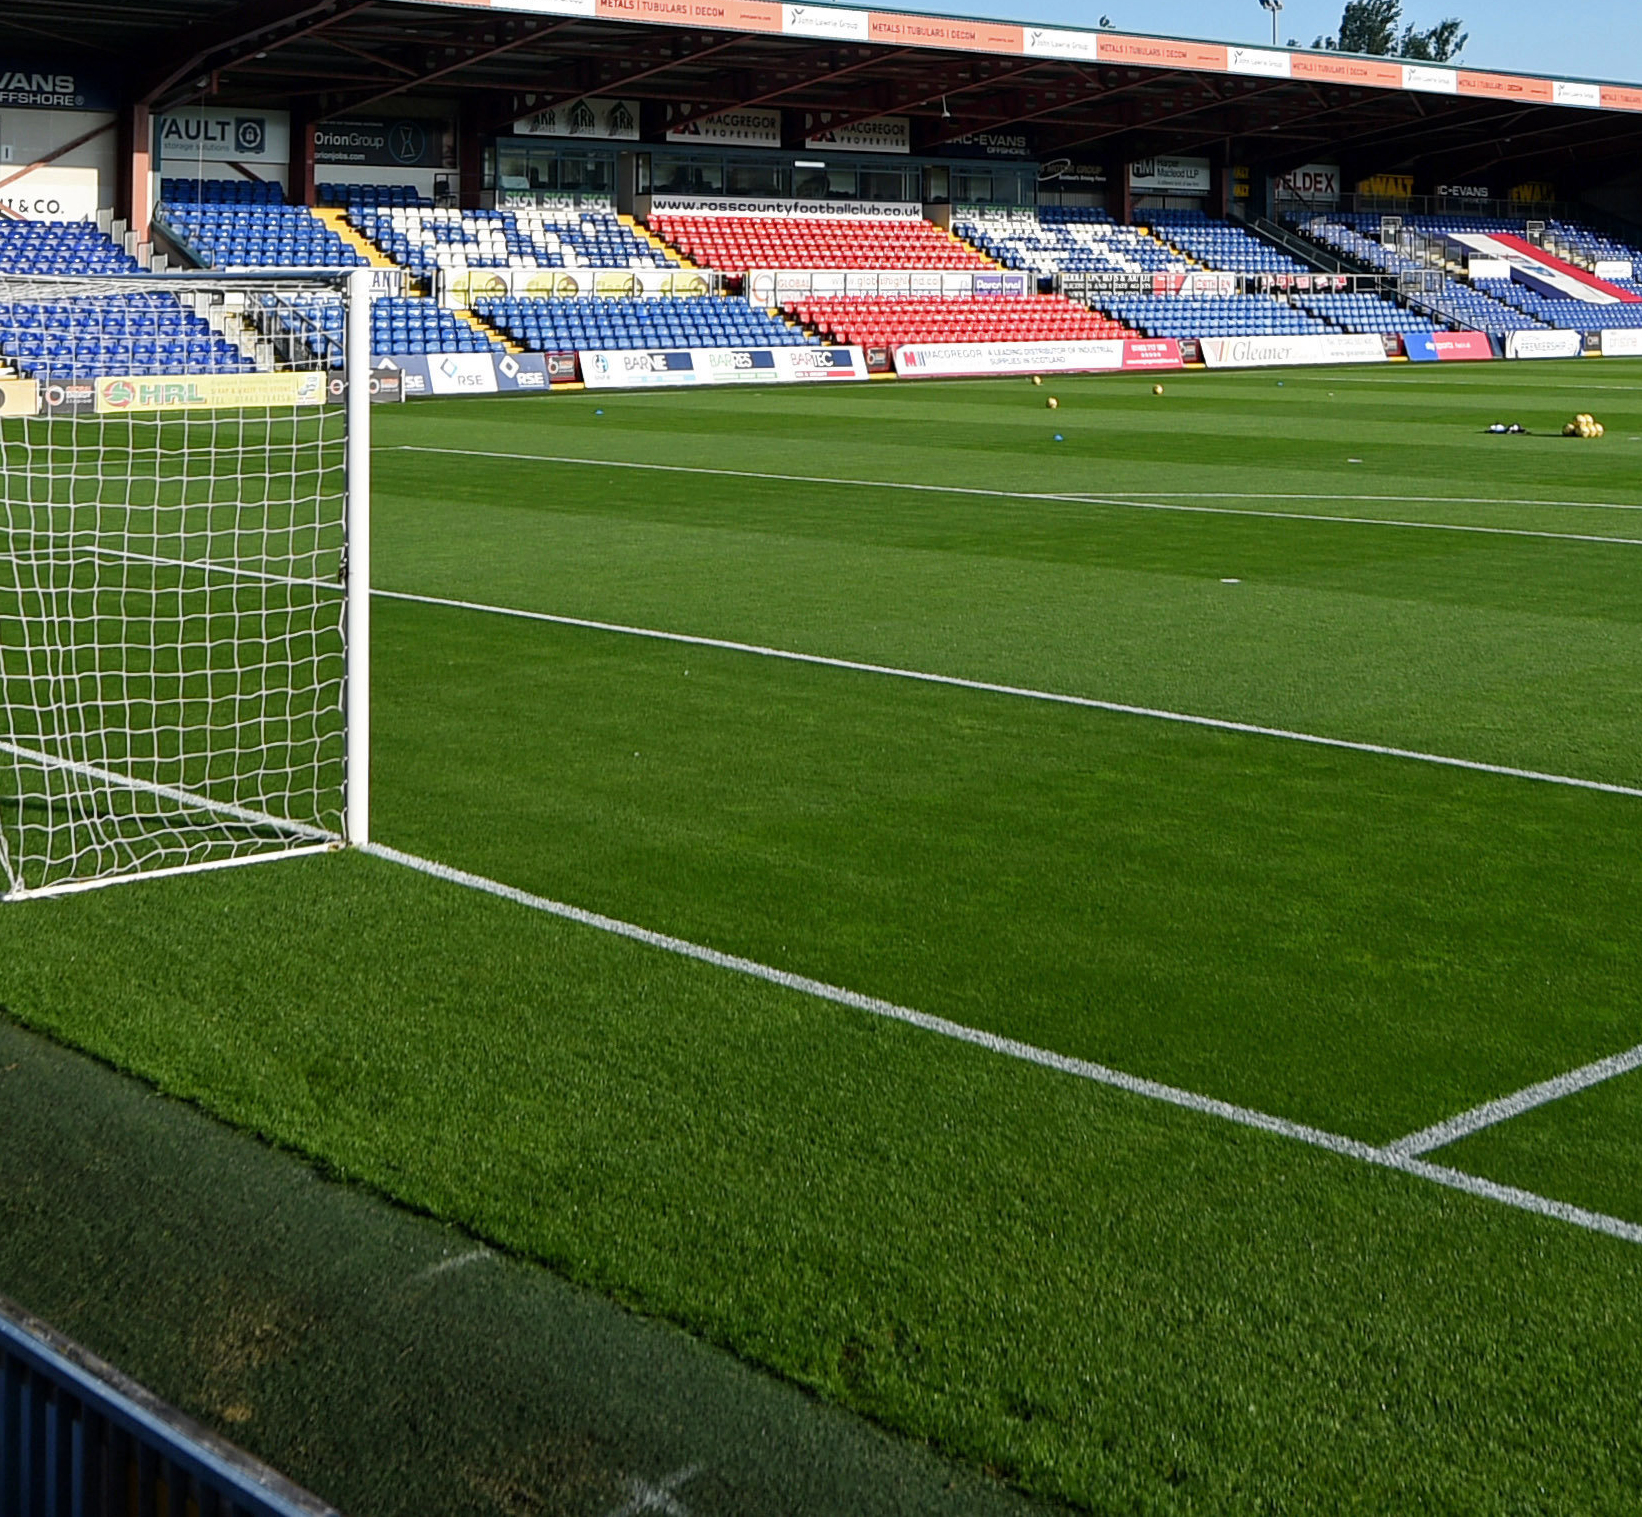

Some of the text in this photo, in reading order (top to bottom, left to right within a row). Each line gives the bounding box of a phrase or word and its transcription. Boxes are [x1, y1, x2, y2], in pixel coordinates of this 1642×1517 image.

[642, 0, 687, 15] TUBULARS
[695, 6, 725, 17] DECOM
[872, 23, 976, 41] METALS TUBULARS DECOM
[705, 114, 776, 128] MACGREGOR
[840, 123, 906, 136] MACGREGOR
[314, 131, 384, 150] OrionGroup
[705, 128, 777, 140] PROPERTIES
[653, 199, 921, 217] www.rosscountyfootballclub.co.uk
[1232, 340, 1292, 362] Gleaner
[457, 374, 484, 386] RSE
[516, 372, 544, 386] RSE
[140, 383, 206, 406] HRL
